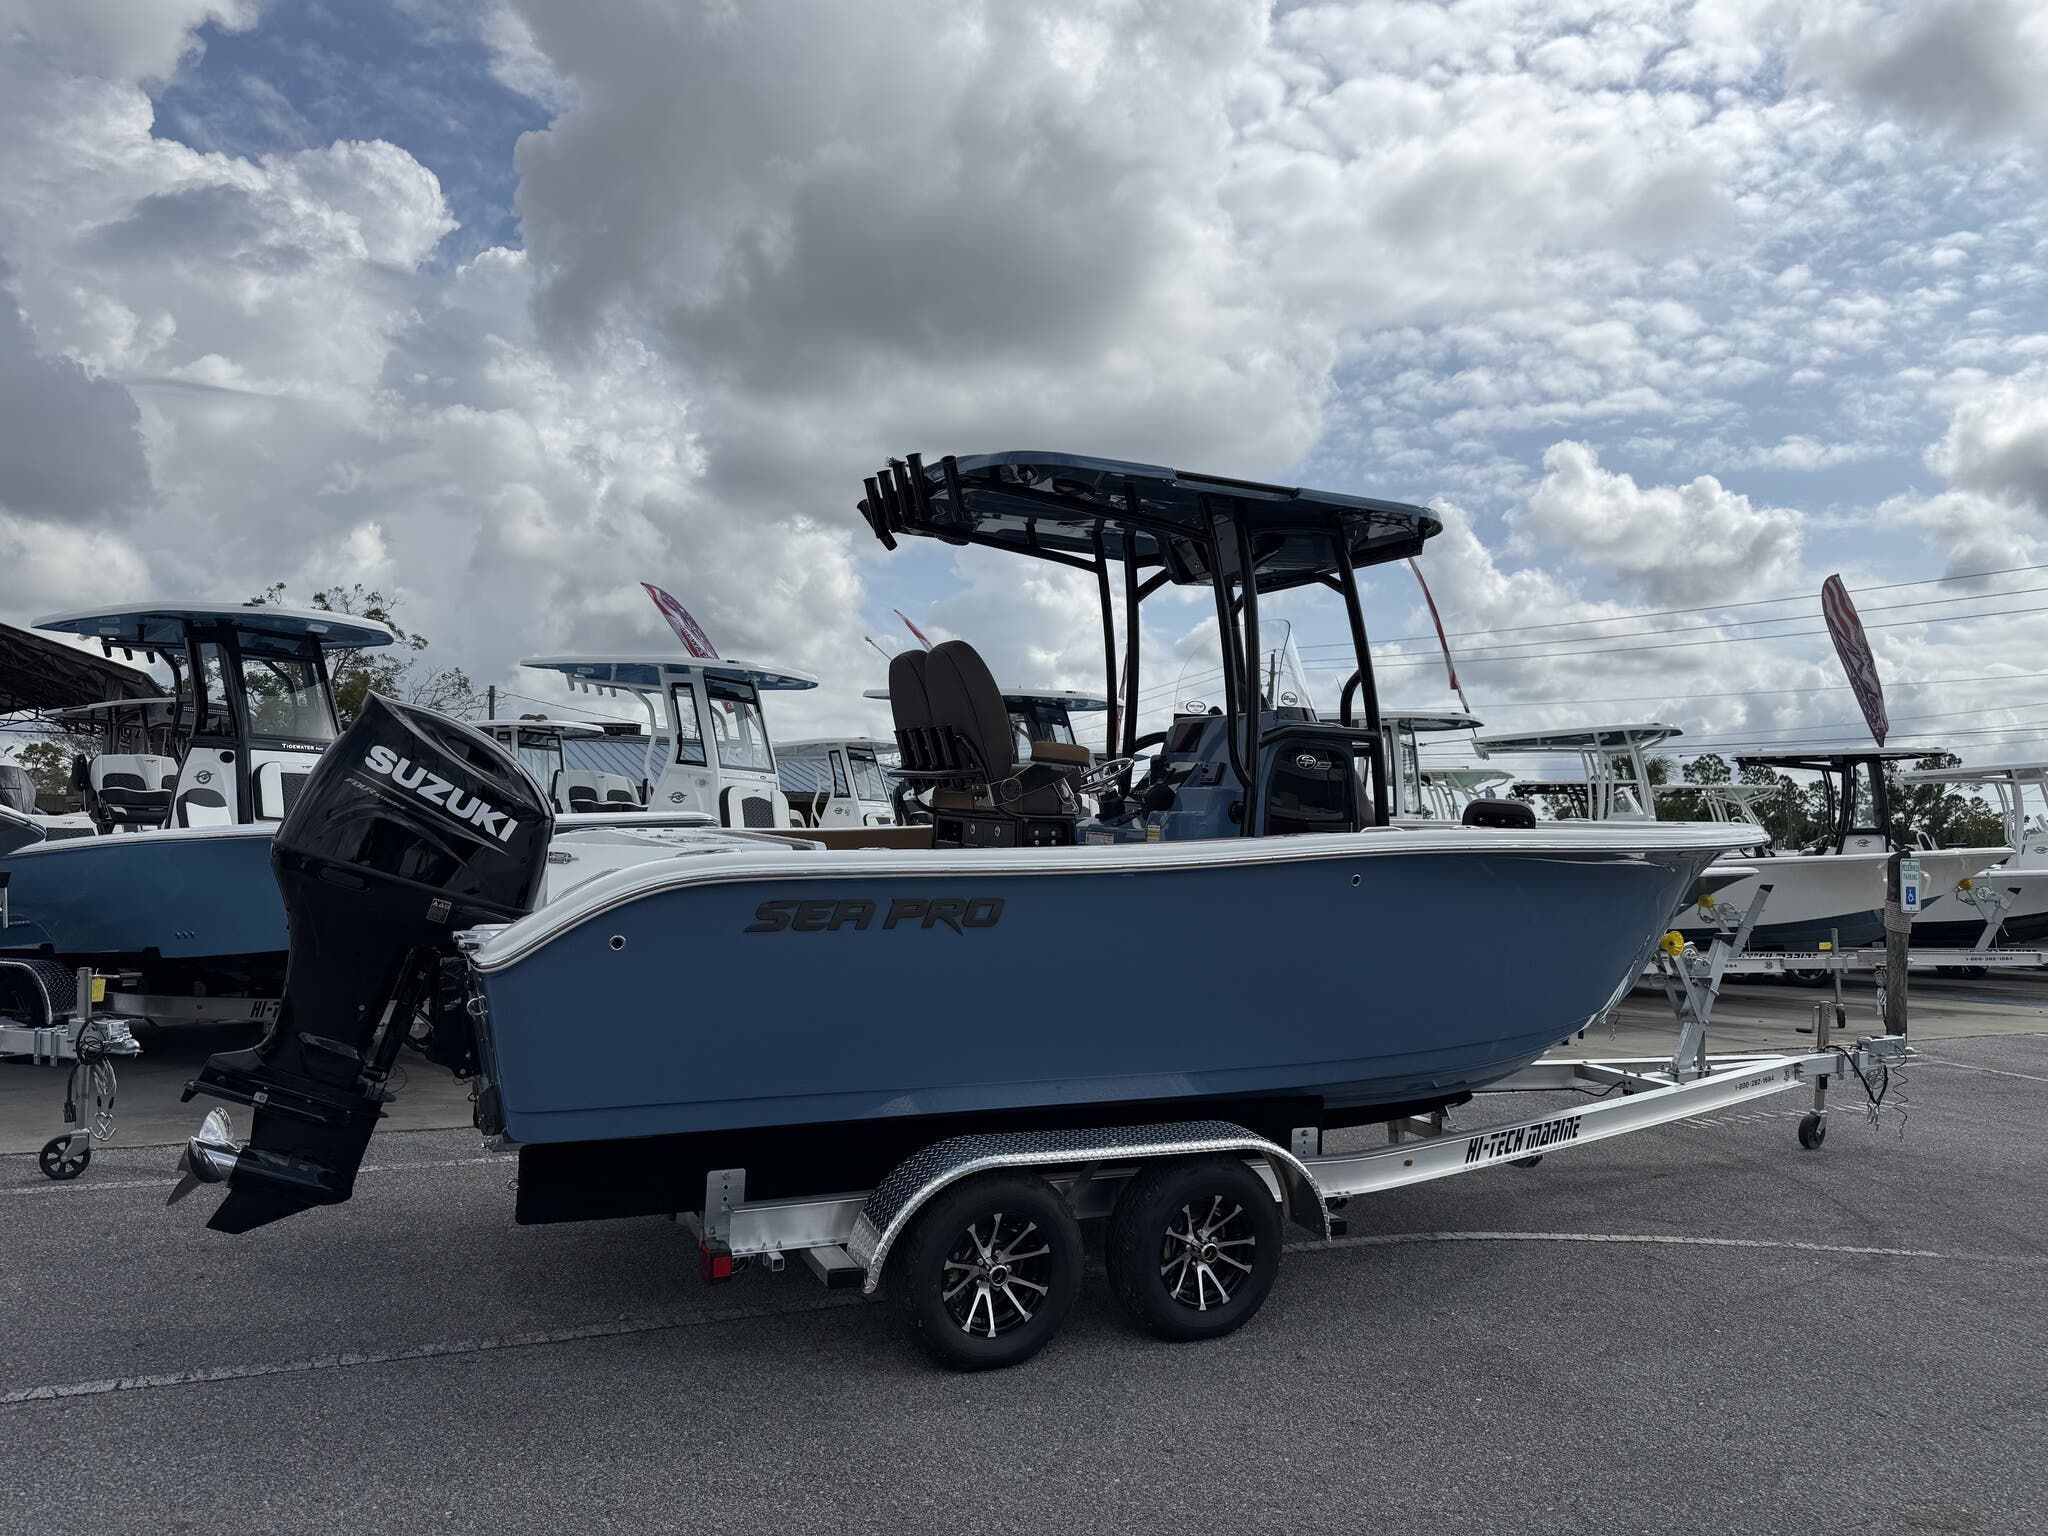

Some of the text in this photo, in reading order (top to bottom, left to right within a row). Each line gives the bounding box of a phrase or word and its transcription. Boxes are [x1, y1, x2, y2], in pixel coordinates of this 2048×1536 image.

[281, 743, 315, 751] TIDEWATER
[365, 745, 518, 842] SUZUKI
[743, 896, 1006, 936] SEA PRO
[1465, 1115, 1582, 1164] HI-TECH MARINE
